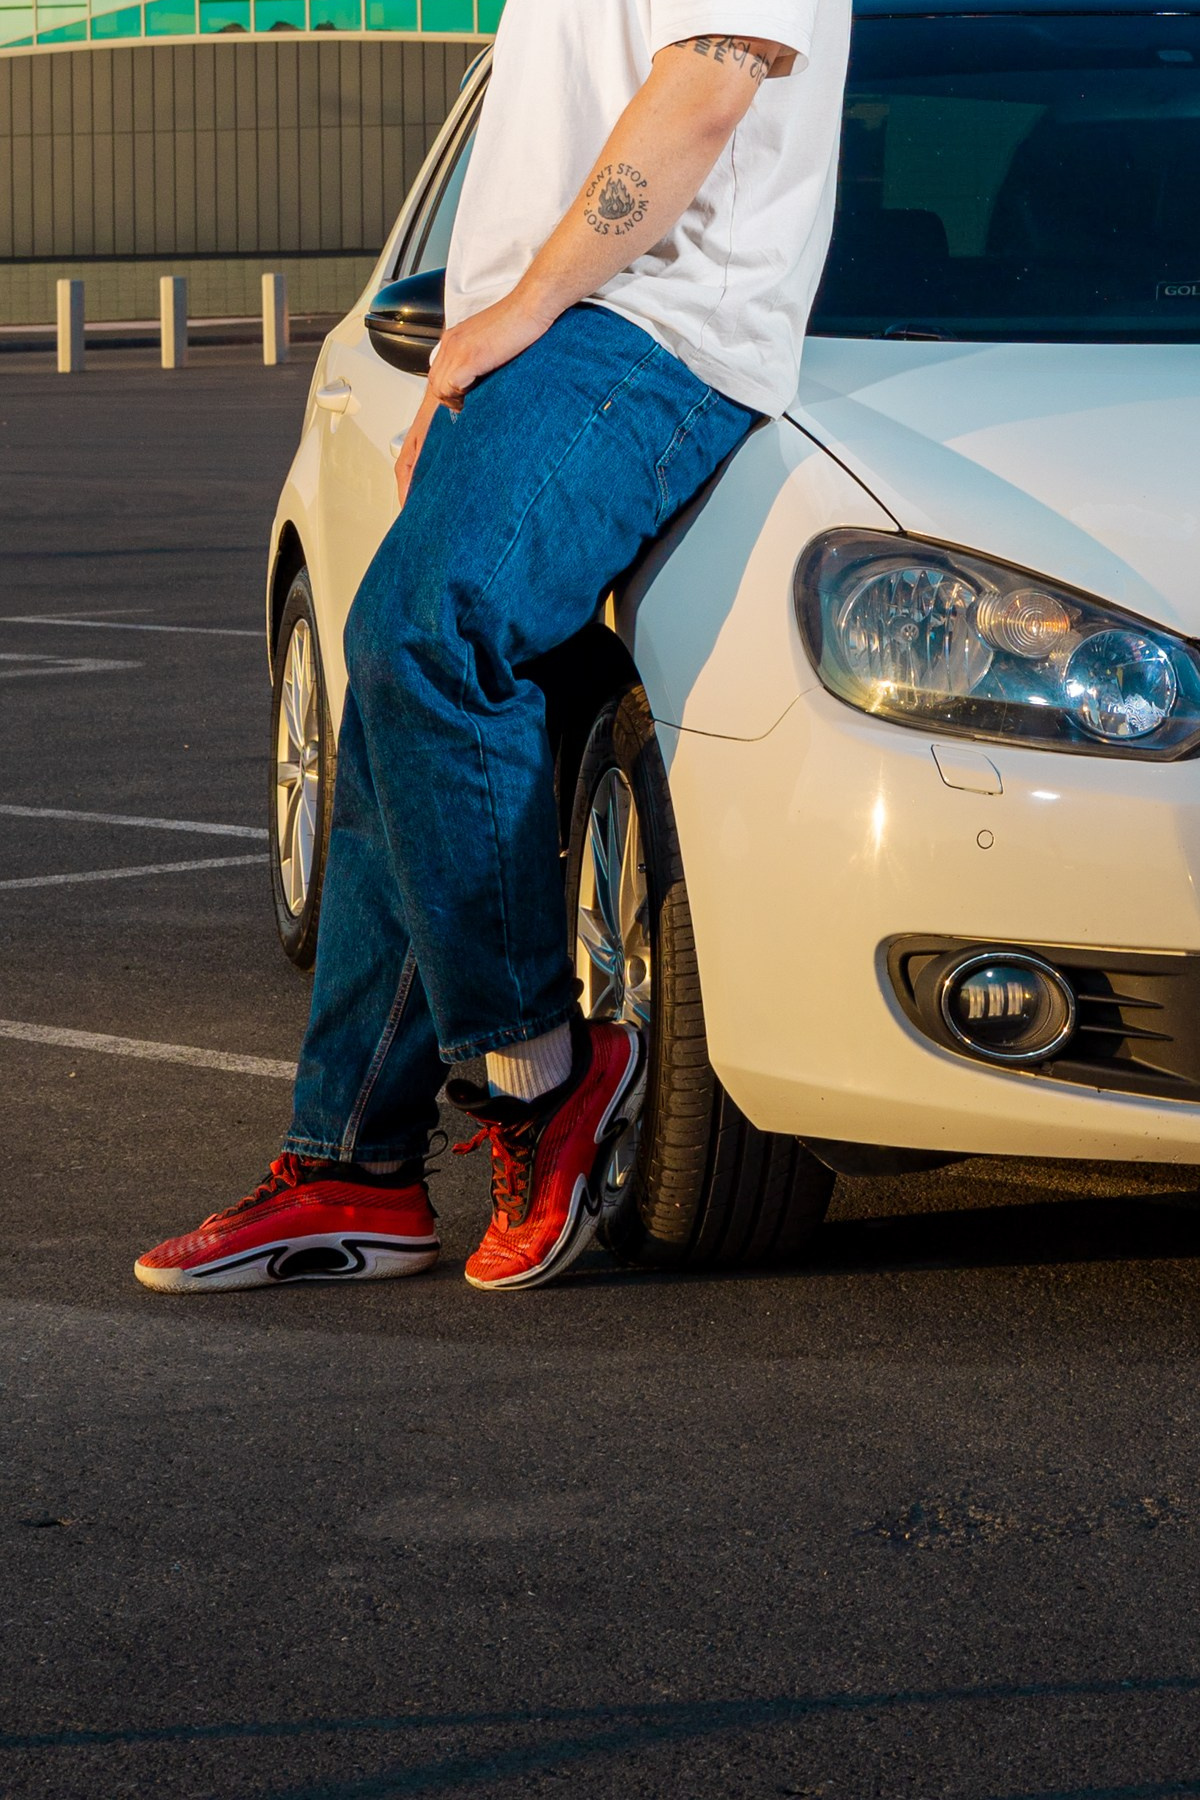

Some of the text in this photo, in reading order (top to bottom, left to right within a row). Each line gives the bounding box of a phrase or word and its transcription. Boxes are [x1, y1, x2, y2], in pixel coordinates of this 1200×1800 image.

[616, 163, 648, 188] STOP
[583, 208, 611, 235] STOP
[614, 200, 649, 236] WON'T
